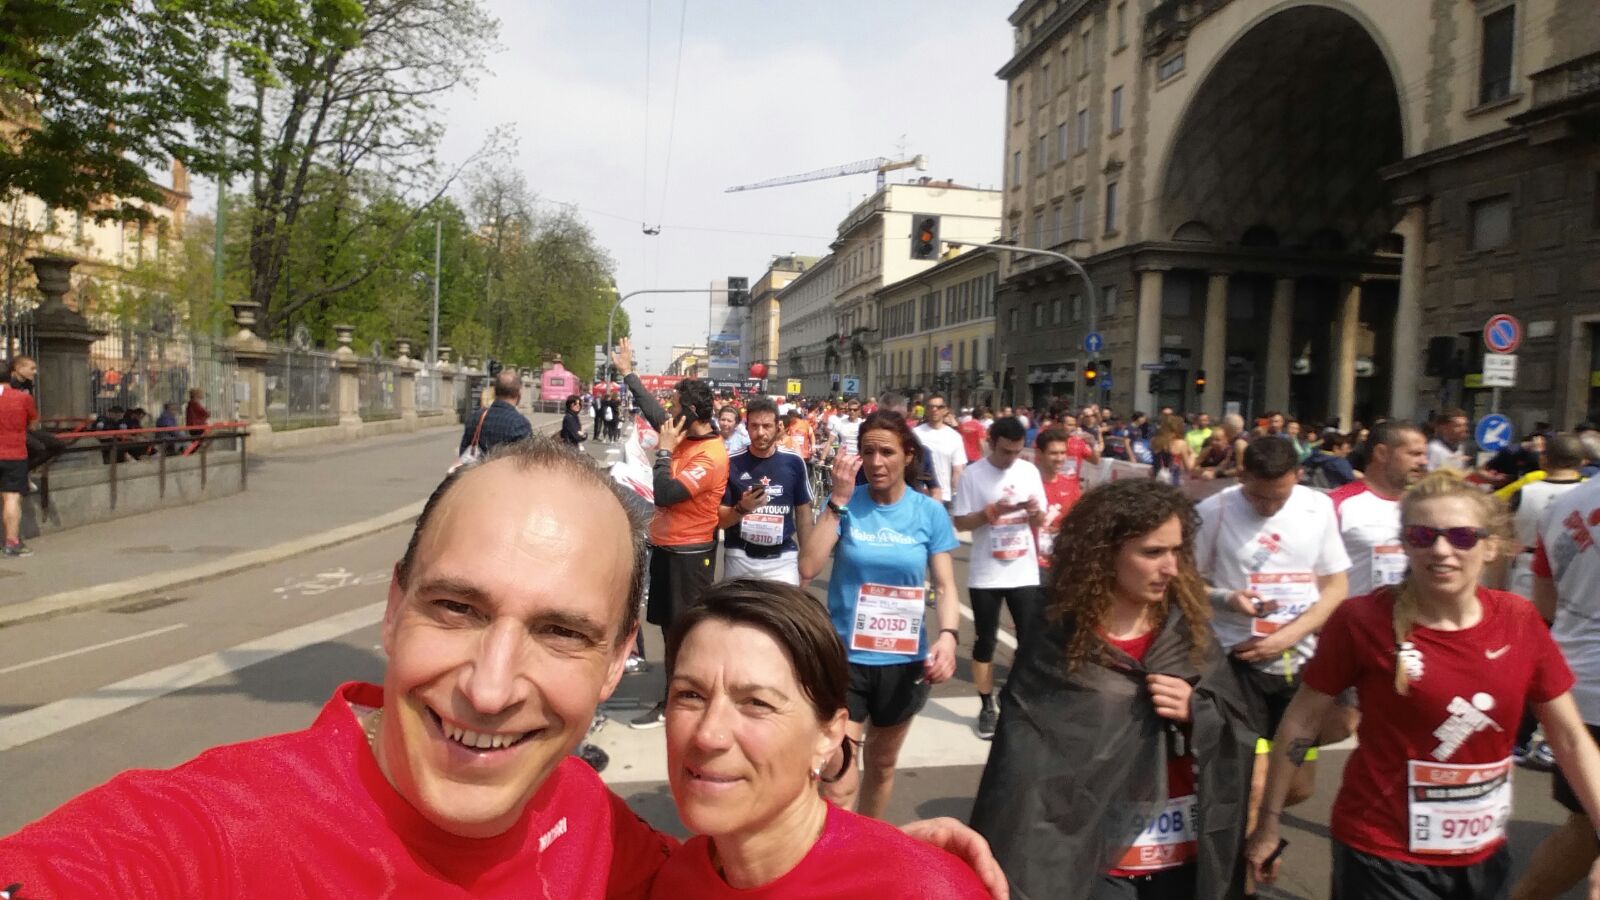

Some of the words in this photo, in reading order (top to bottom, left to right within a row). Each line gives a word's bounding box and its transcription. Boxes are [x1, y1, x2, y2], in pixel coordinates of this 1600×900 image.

[847, 380, 856, 392] 2
[750, 533, 773, 544] 2311D
[868, 616, 908, 632] 2013D
[875, 637, 897, 649] EA7
[1139, 844, 1176, 862] EA7
